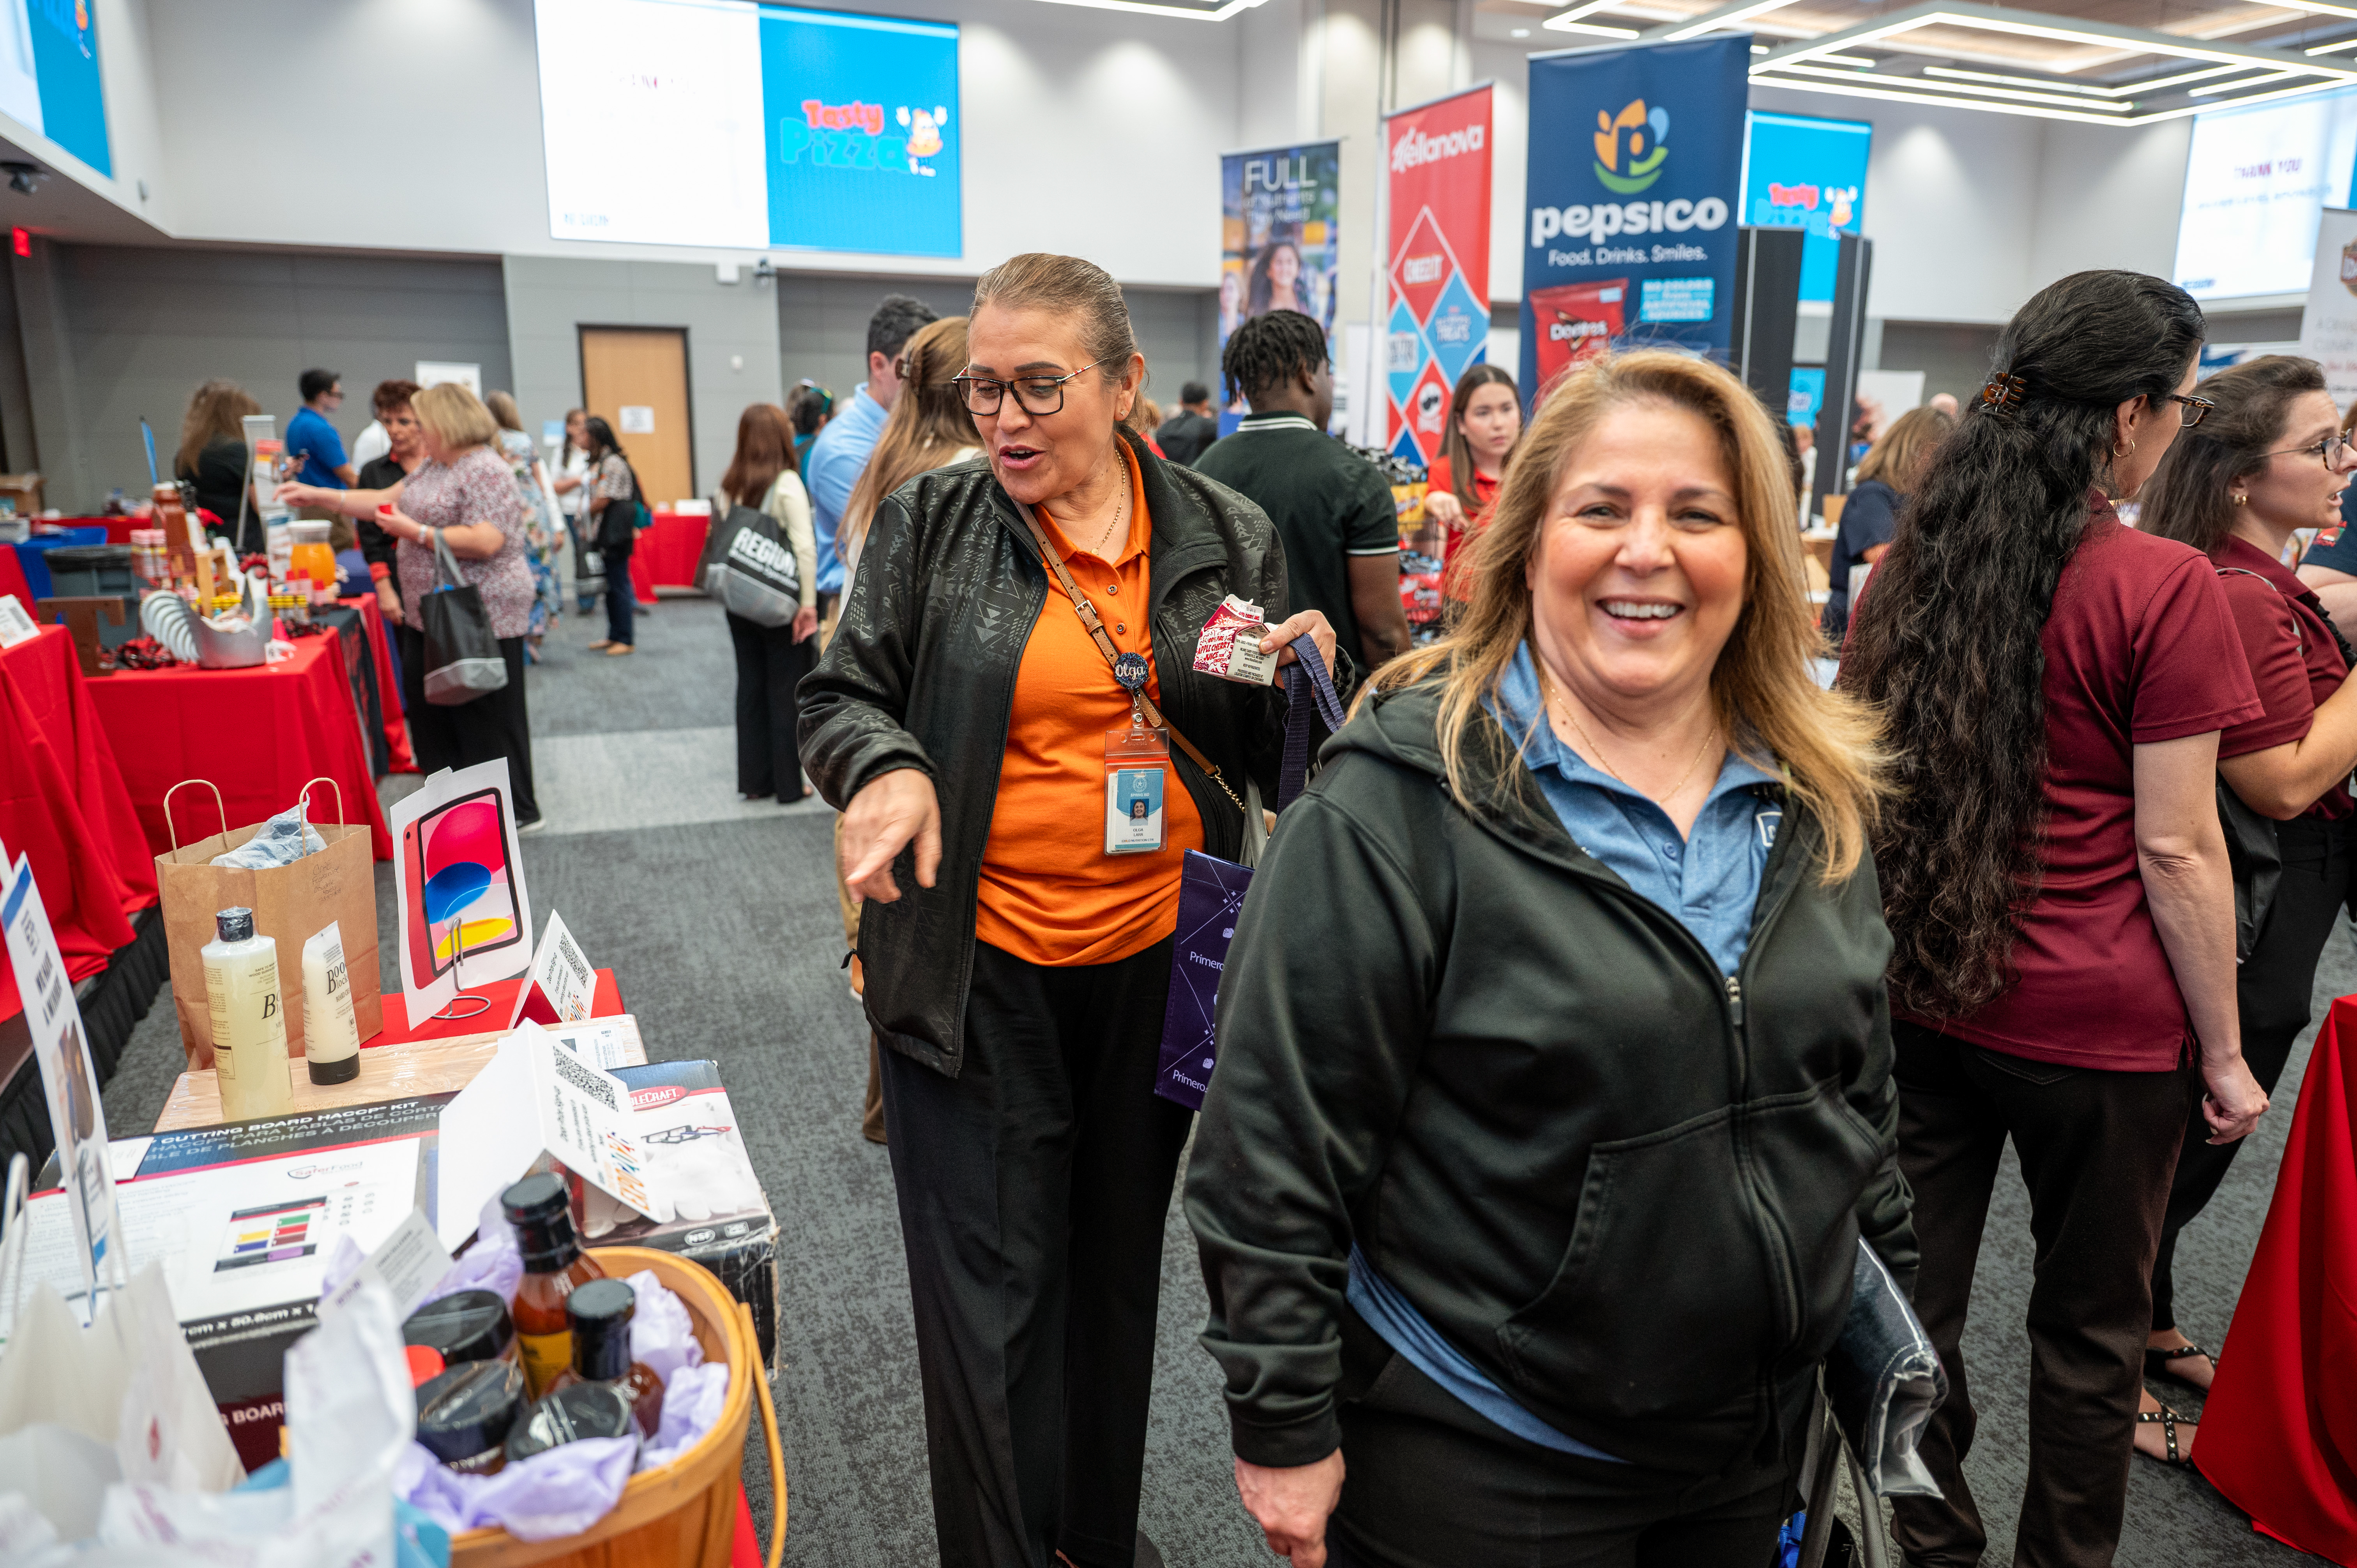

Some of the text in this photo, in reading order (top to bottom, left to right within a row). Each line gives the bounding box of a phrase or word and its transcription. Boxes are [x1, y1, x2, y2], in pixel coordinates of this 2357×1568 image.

[802, 100, 884, 135] Tasty
[781, 118, 910, 173] Pizza
[1244, 156, 1318, 192] FULL
[1769, 183, 1819, 211] Tasty
[1531, 197, 1729, 248] pepsico
[1548, 244, 1708, 267] Food. Drinks. Smiles.
[1663, 279, 1713, 291] COLORS
[1550, 321, 1608, 341] Doritos
[1197, 641, 1231, 655] APPLE CHERRY
[1204, 652, 1219, 661] JUICE
[1115, 663, 1146, 680] Olga
[161, 1127, 244, 1144] CUTTING
[248, 1117, 313, 1131] BOARD
[391, 1102, 419, 1111] KIT
[186, 1146, 212, 1155] DE
[217, 1131, 317, 1150] PLANCHES
[322, 1126, 334, 1134] À
[339, 1112, 438, 1132] DÉCOUPER
[231, 1127, 281, 1141] PARA
[289, 1117, 355, 1132] TABLAS
[687, 1231, 713, 1243] NSF
[217, 1321, 227, 1330] x
[292, 1306, 302, 1315] x
